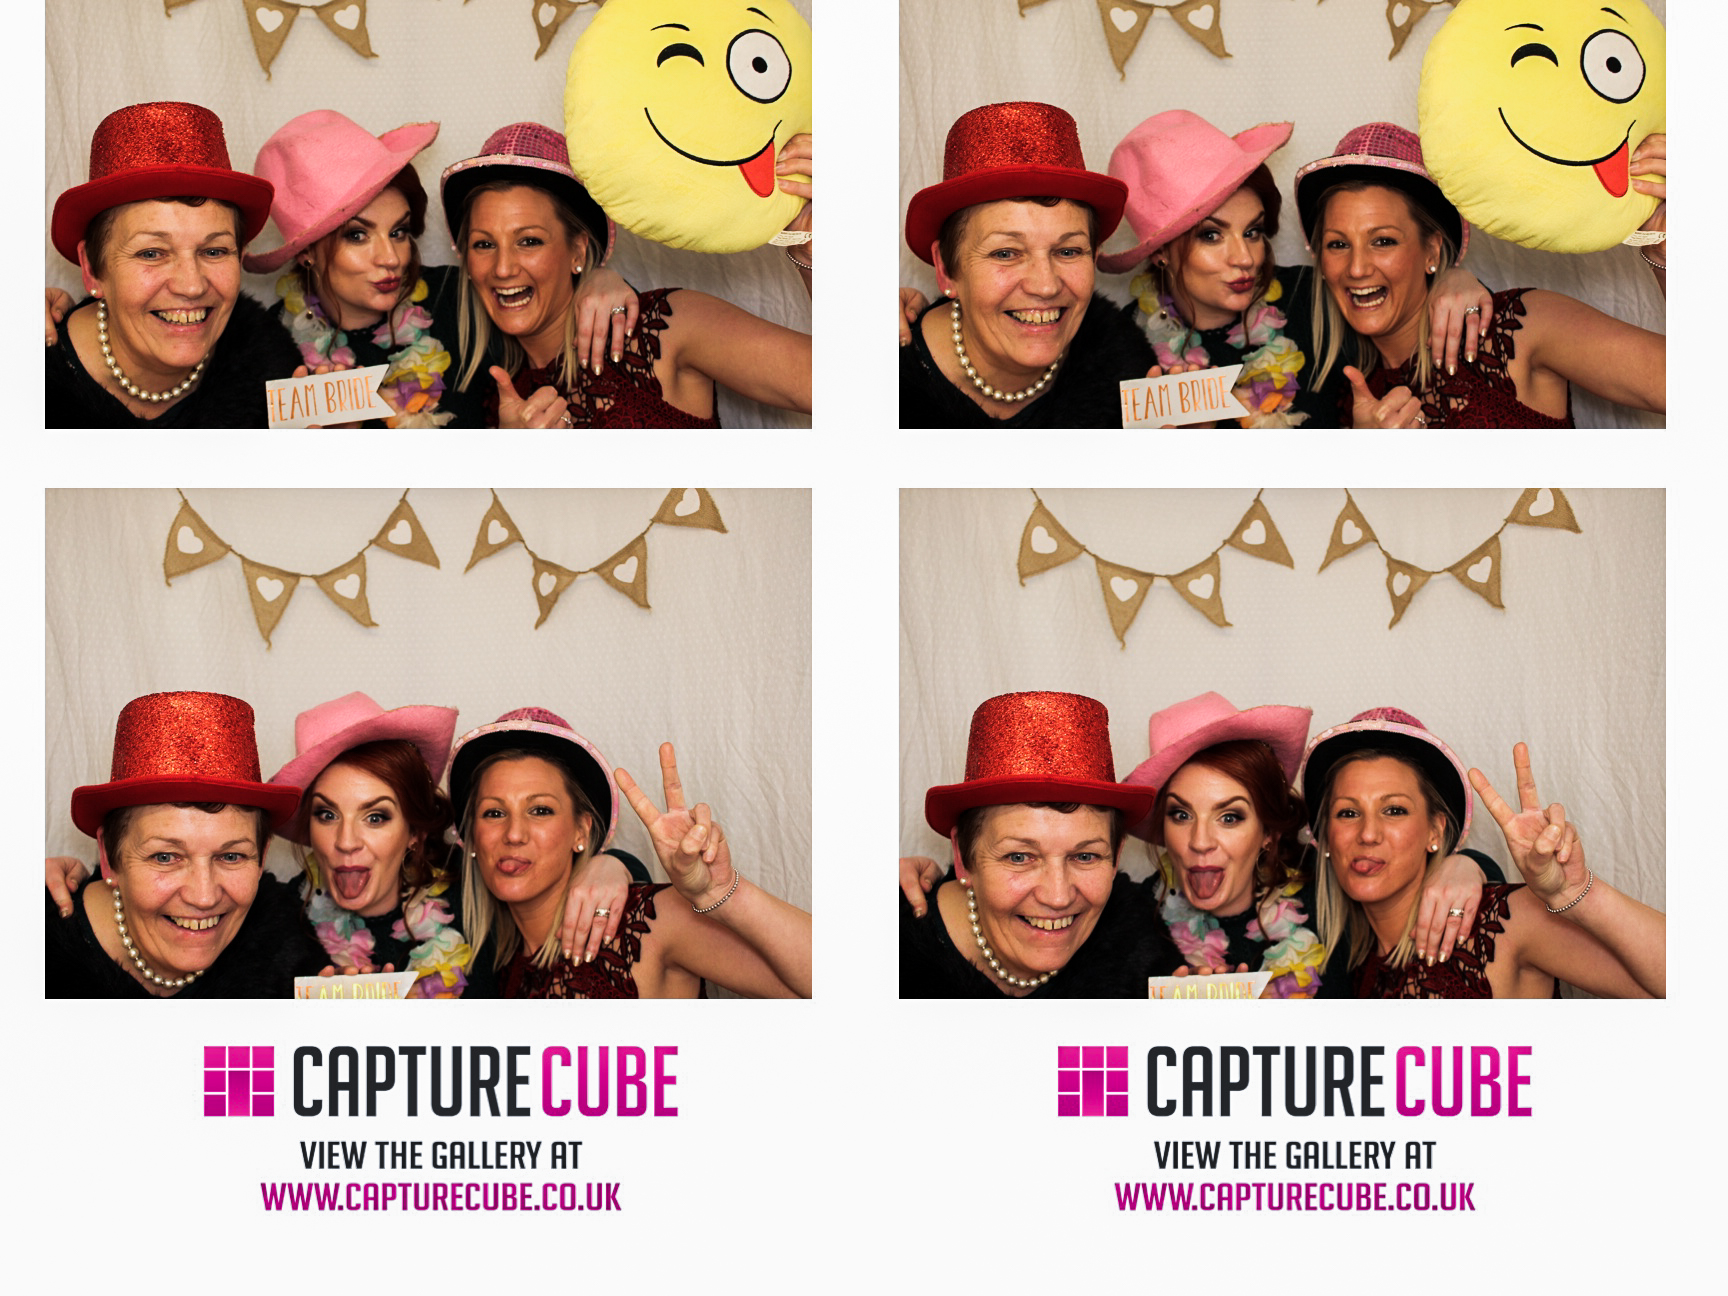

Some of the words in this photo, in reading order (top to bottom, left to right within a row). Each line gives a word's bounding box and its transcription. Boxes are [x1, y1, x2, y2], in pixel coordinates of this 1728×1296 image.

[267, 383, 318, 423] TEAM
[324, 375, 377, 414] BRIDE
[1121, 383, 1172, 423] TEAM
[1178, 375, 1231, 414] BRIDE
[293, 1045, 531, 1117] CAPTURE
[541, 1045, 679, 1117] CUBE
[1147, 1045, 1385, 1117] CAPTURE
[1395, 1045, 1533, 1117] CUBE
[300, 1141, 367, 1169] VIEW
[375, 1141, 423, 1169] THE
[431, 1141, 542, 1169] GALLERY
[550, 1141, 583, 1169] AT
[1154, 1141, 1221, 1169] VIEW
[1229, 1141, 1277, 1169] THE
[1285, 1141, 1396, 1169] GALLERY
[1404, 1141, 1437, 1169] AT
[260, 1182, 622, 1211] WWW.CAPTURECUBE.CO.UK
[1114, 1182, 1476, 1211] WWW.CAPTURECUBE.CO.UK
